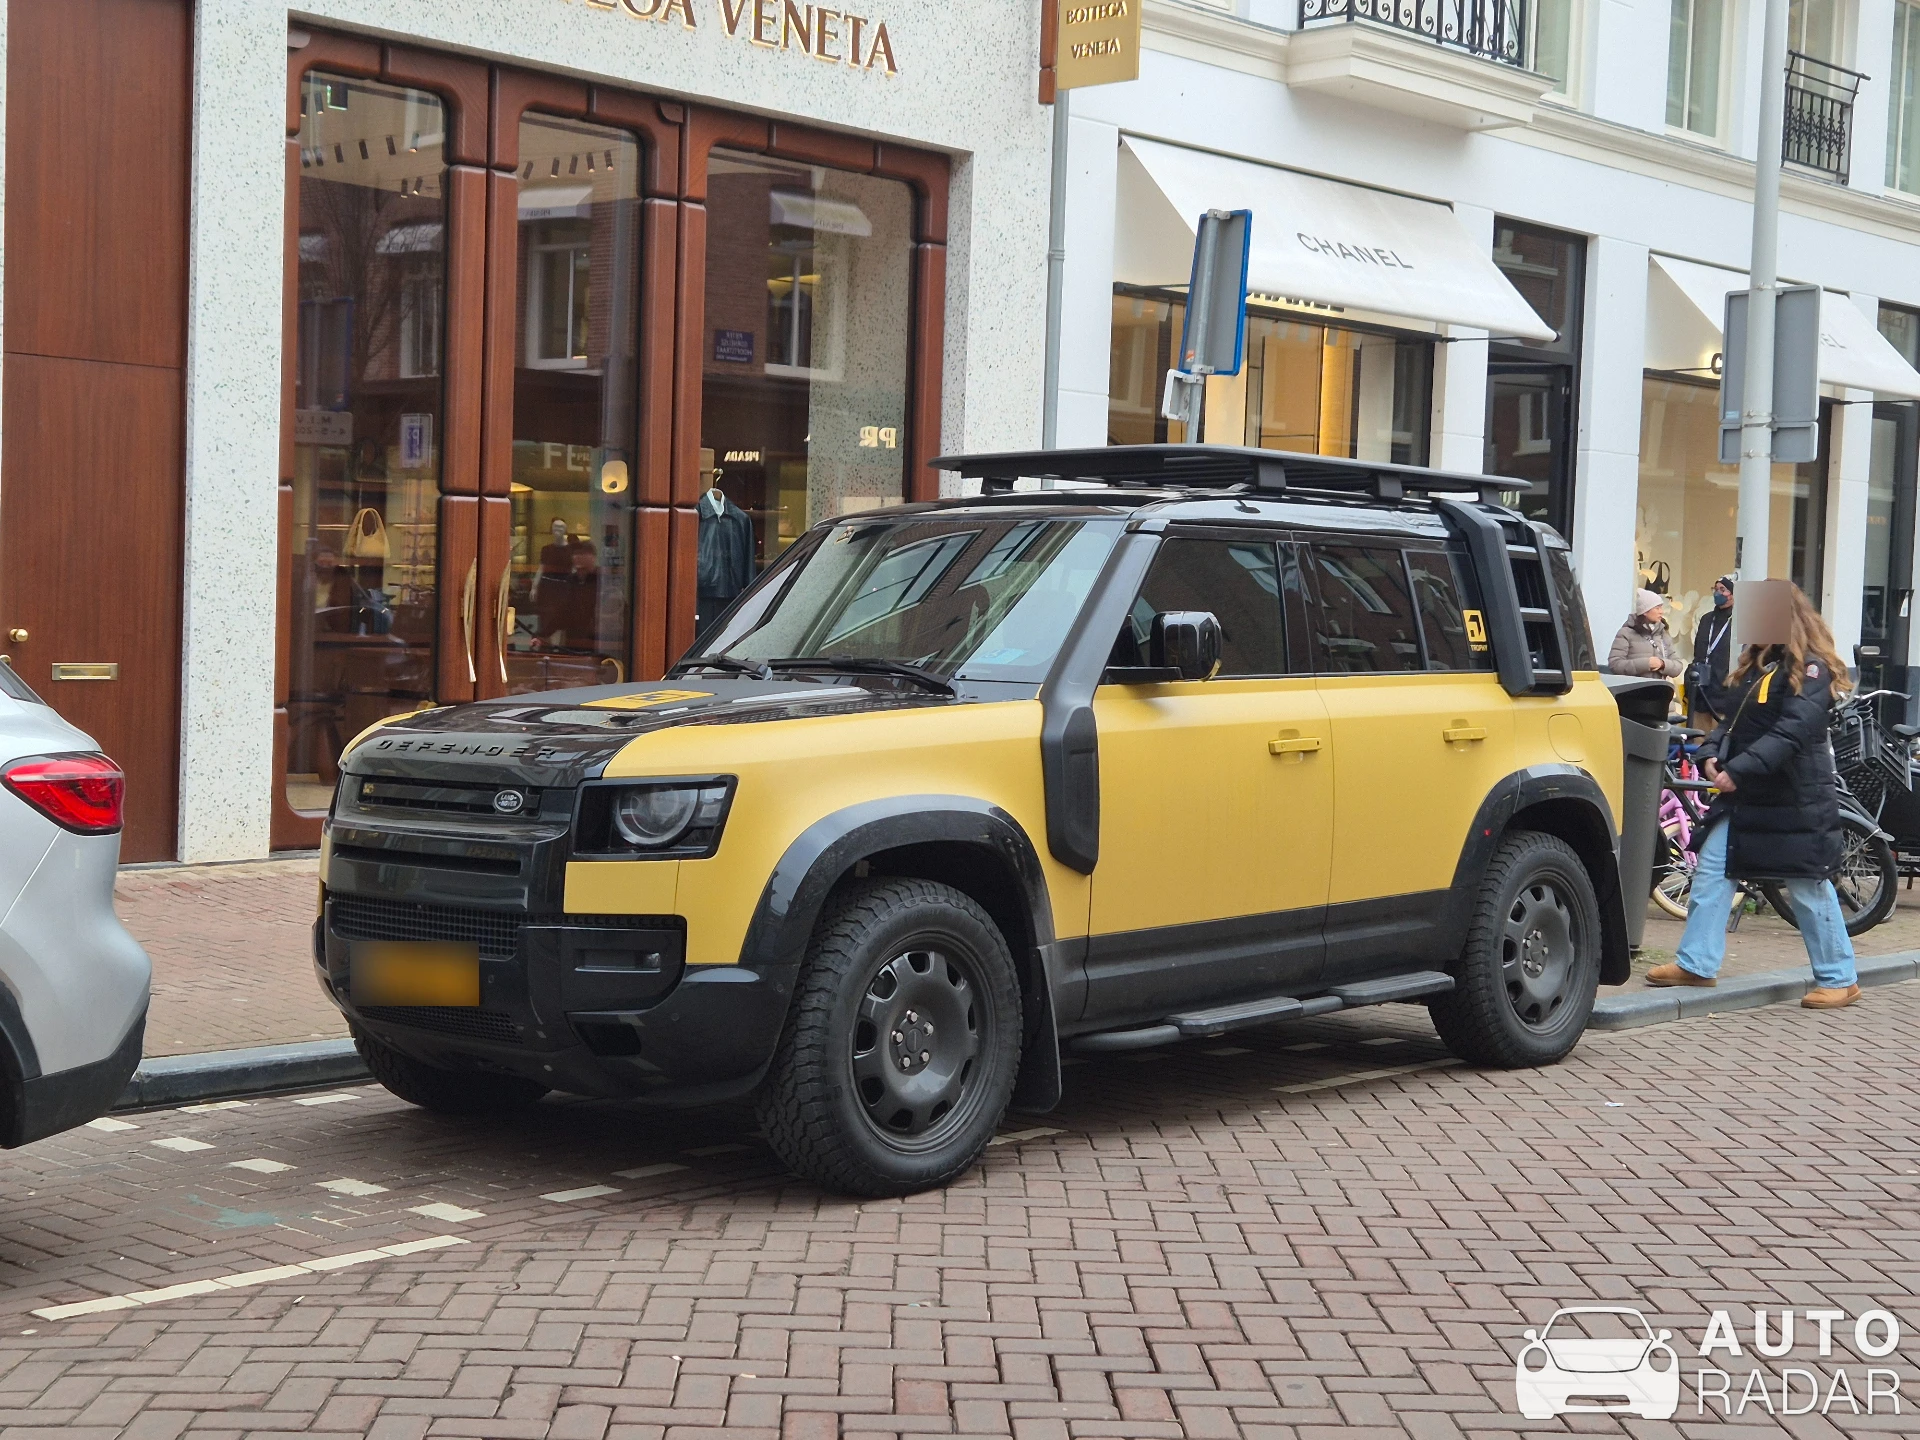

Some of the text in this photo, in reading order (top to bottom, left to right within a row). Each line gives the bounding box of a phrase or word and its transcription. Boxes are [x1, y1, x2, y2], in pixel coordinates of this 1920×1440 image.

[1066, 1, 1127, 25] BOTTEGA
[718, 0, 898, 74] VENETA
[1071, 38, 1120, 59] VENETA
[1296, 232, 1415, 270] CHANEL
[1470, 644, 1488, 652] TROPHY
[376, 739, 558, 759] DEFENDER
